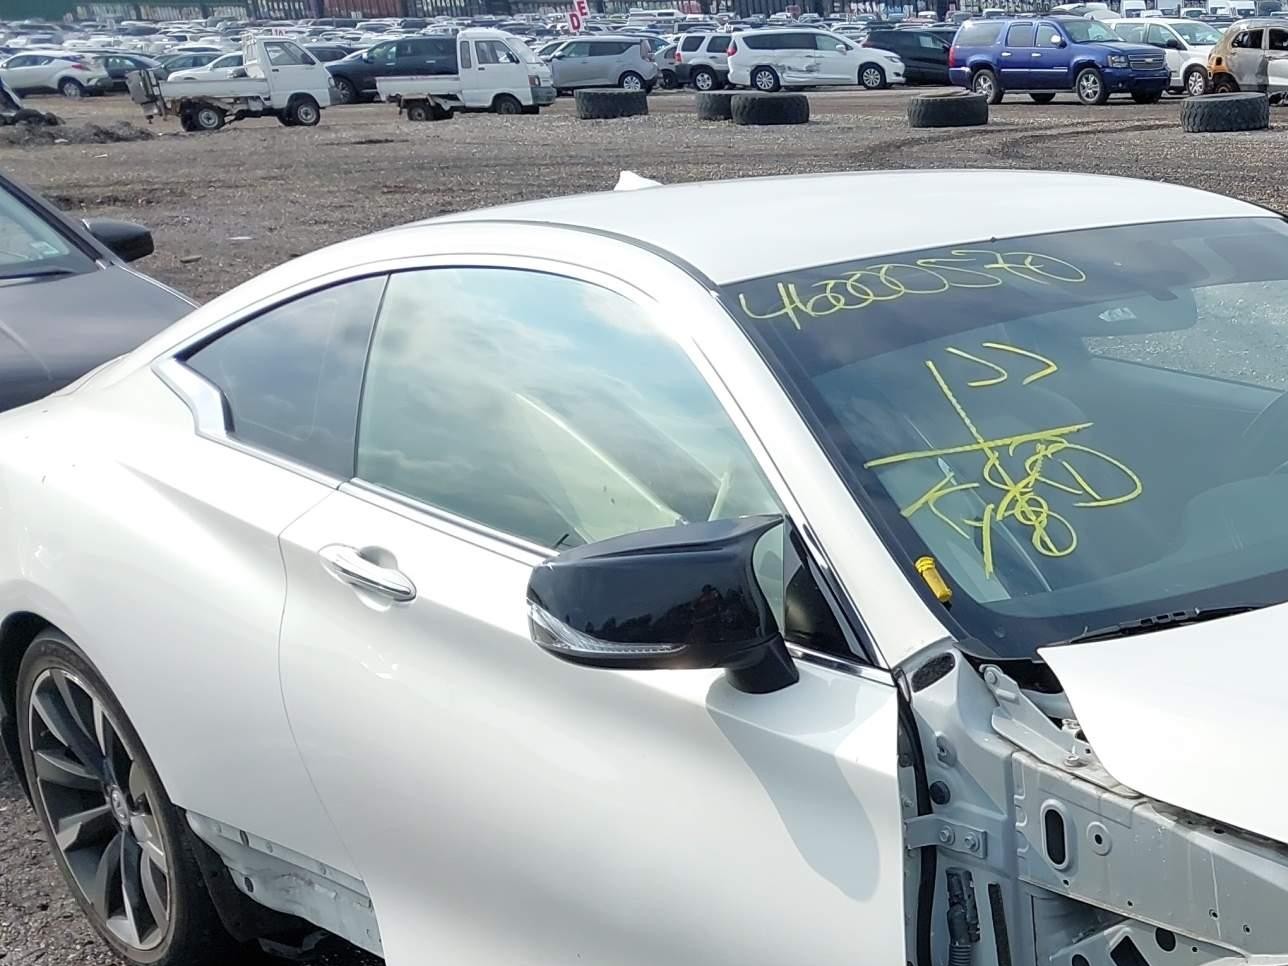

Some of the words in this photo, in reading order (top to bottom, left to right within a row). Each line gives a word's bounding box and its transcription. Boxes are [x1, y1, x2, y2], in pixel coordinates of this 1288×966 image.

[577, 1, 588, 17] E
[569, 13, 581, 30] D
[738, 249, 1086, 331] 46000570
